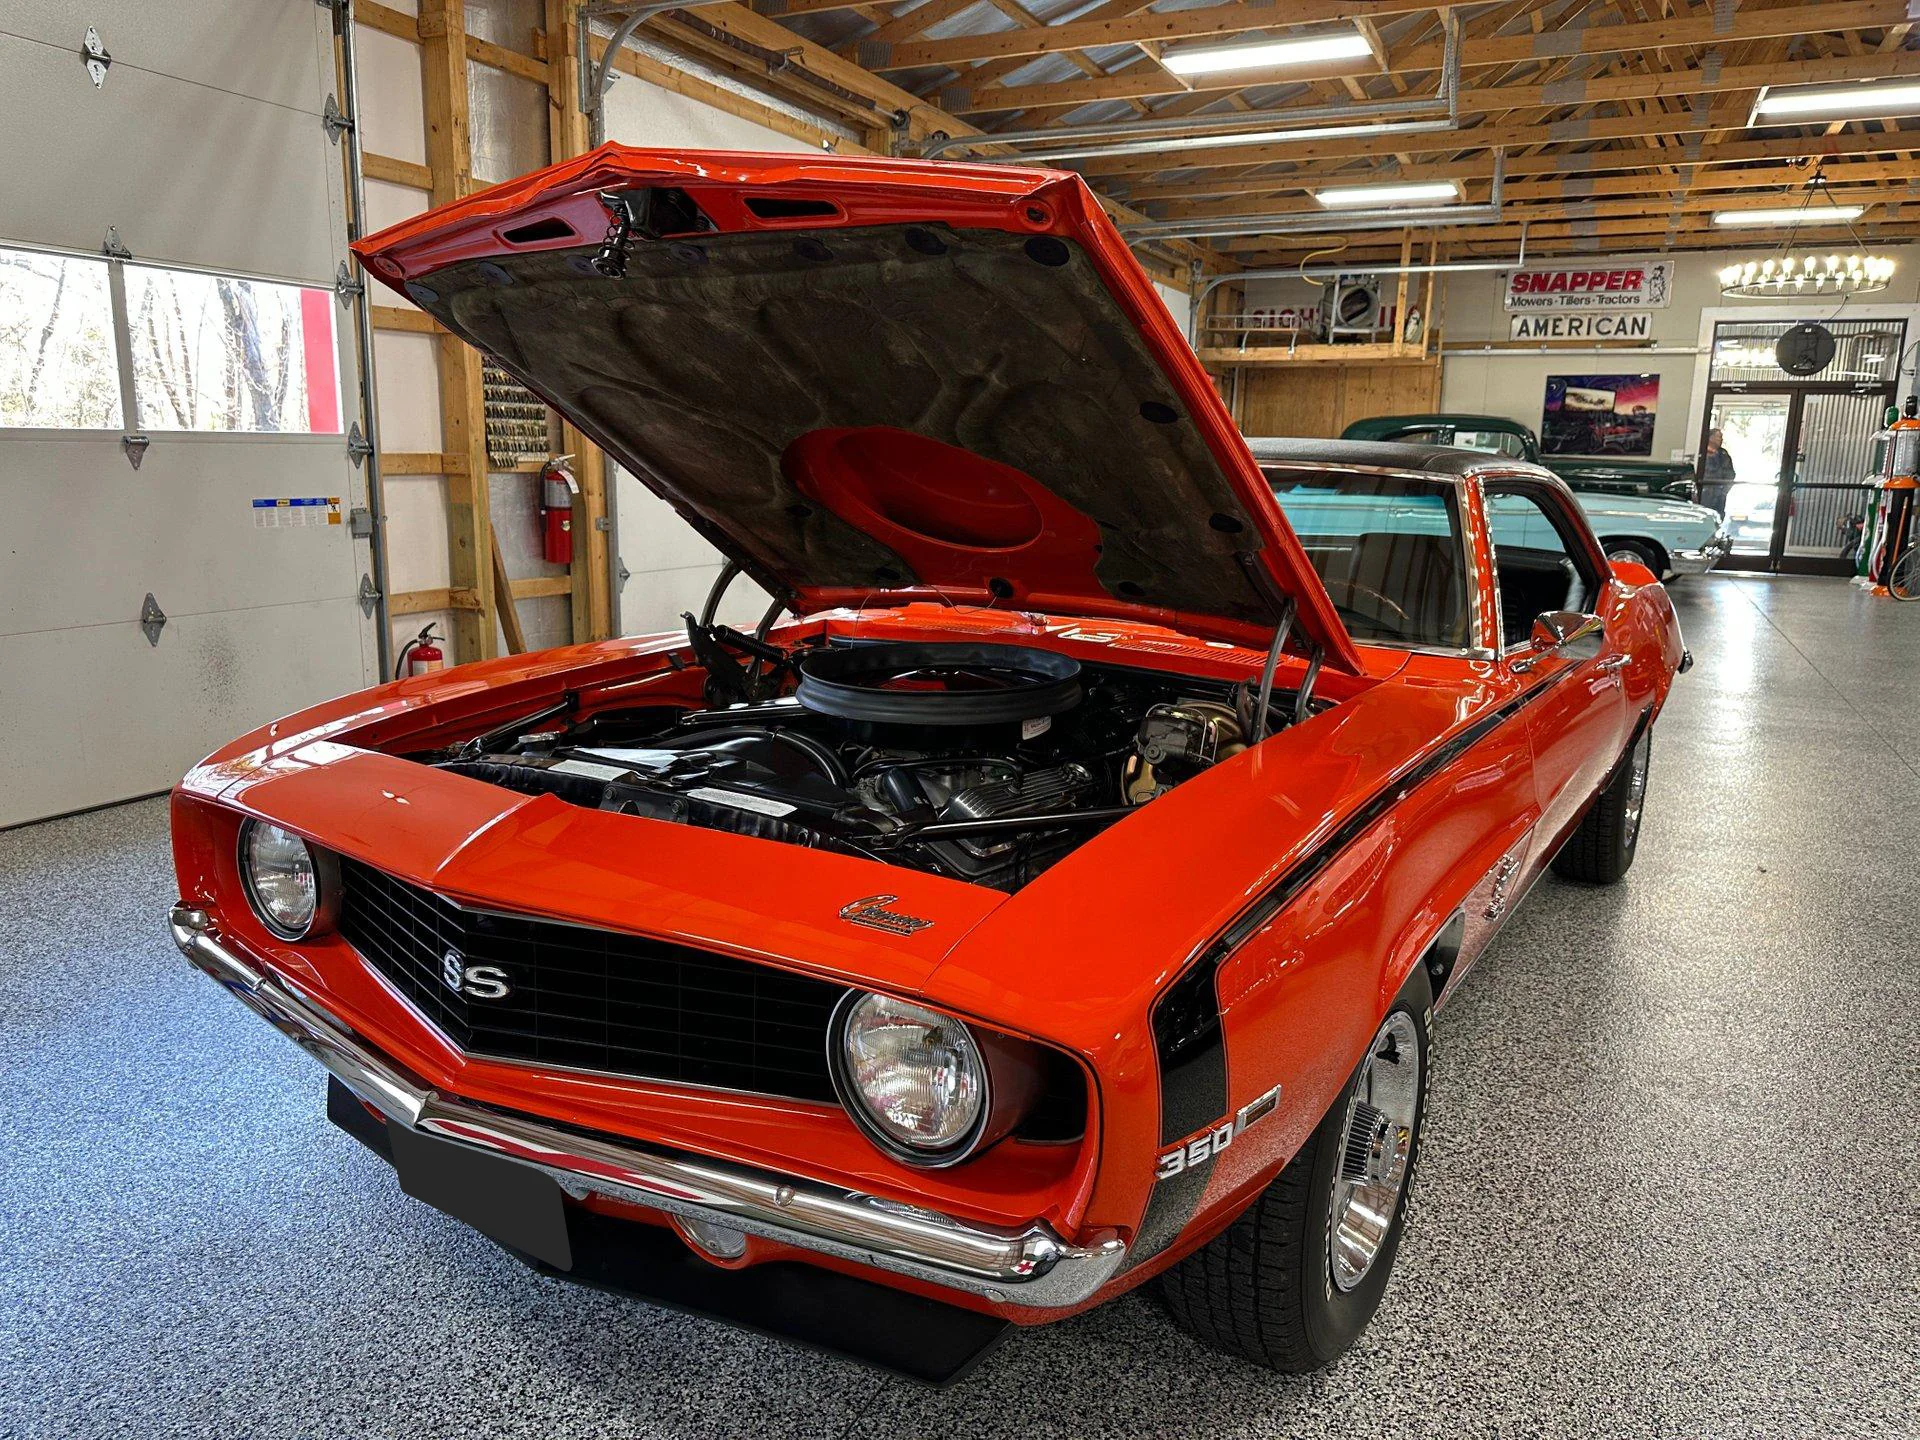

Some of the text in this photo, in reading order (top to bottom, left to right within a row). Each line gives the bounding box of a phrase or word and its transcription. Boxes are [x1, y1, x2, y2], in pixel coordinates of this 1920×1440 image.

[1510, 269, 1646, 293] SNAPPER
[1510, 294, 1641, 307] Mowers Tillers Tractors
[1517, 316, 1647, 338] AMERICAN
[443, 949, 510, 999] SS
[1155, 1122, 1234, 1180] 350
